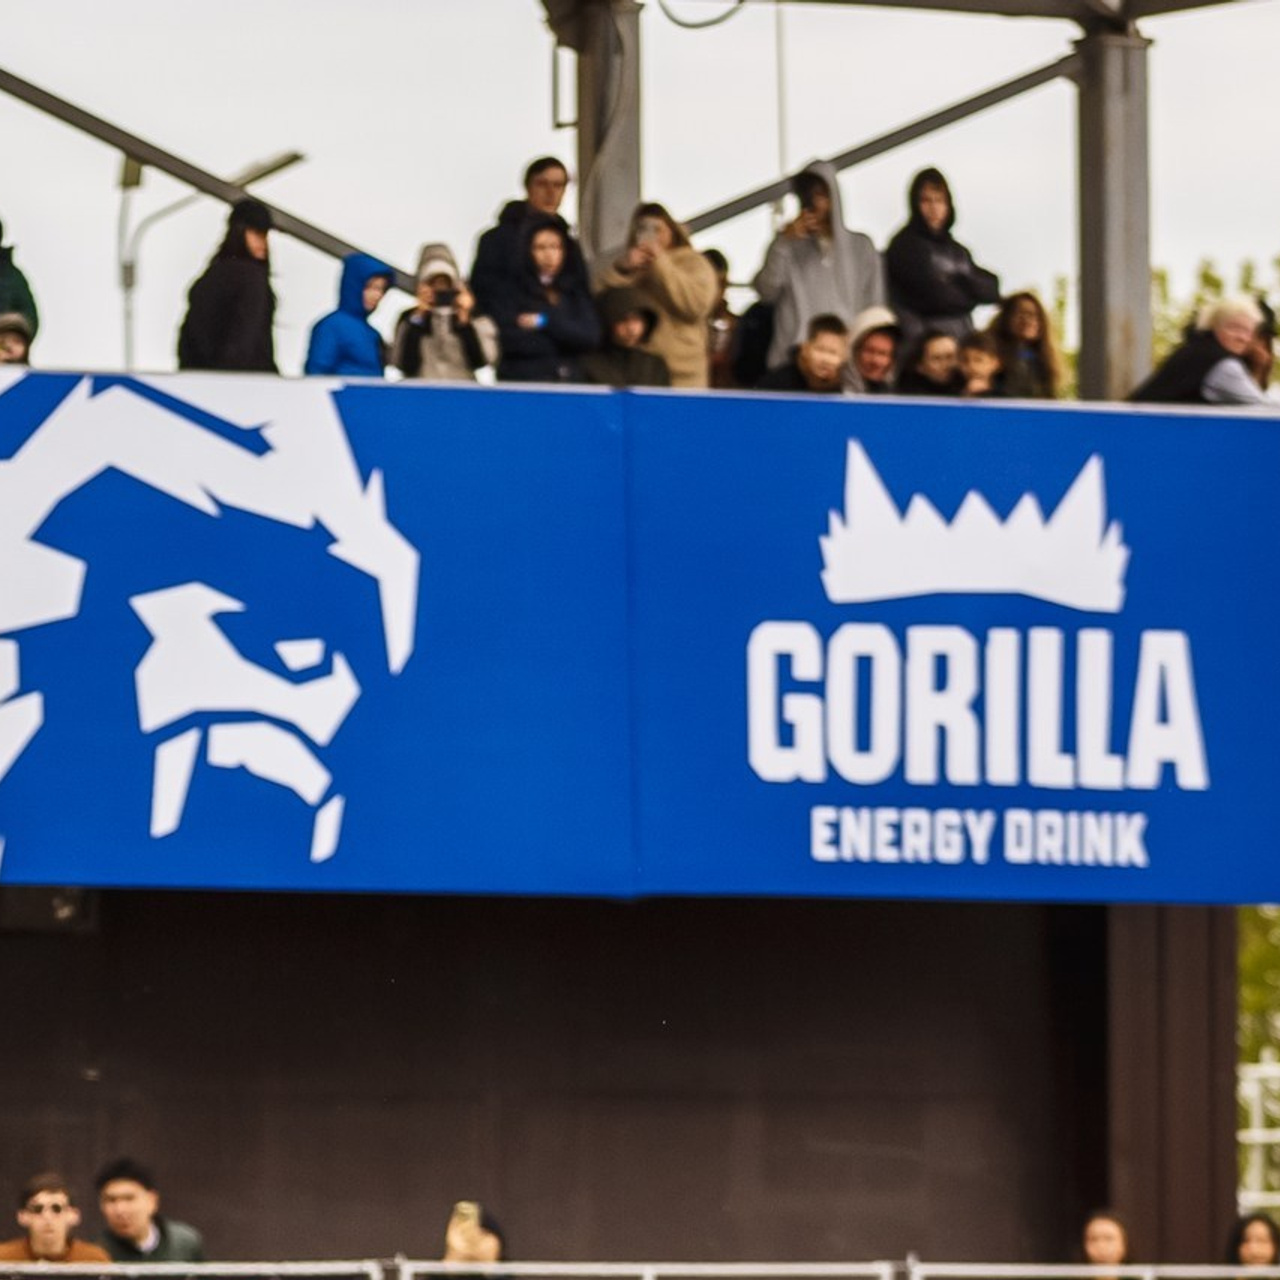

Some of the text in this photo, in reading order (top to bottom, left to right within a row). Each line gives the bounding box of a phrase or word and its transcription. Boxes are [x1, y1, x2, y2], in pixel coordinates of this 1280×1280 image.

[746, 620, 1210, 791] GORILLA
[810, 805, 1150, 868] ENERGY DRINK
